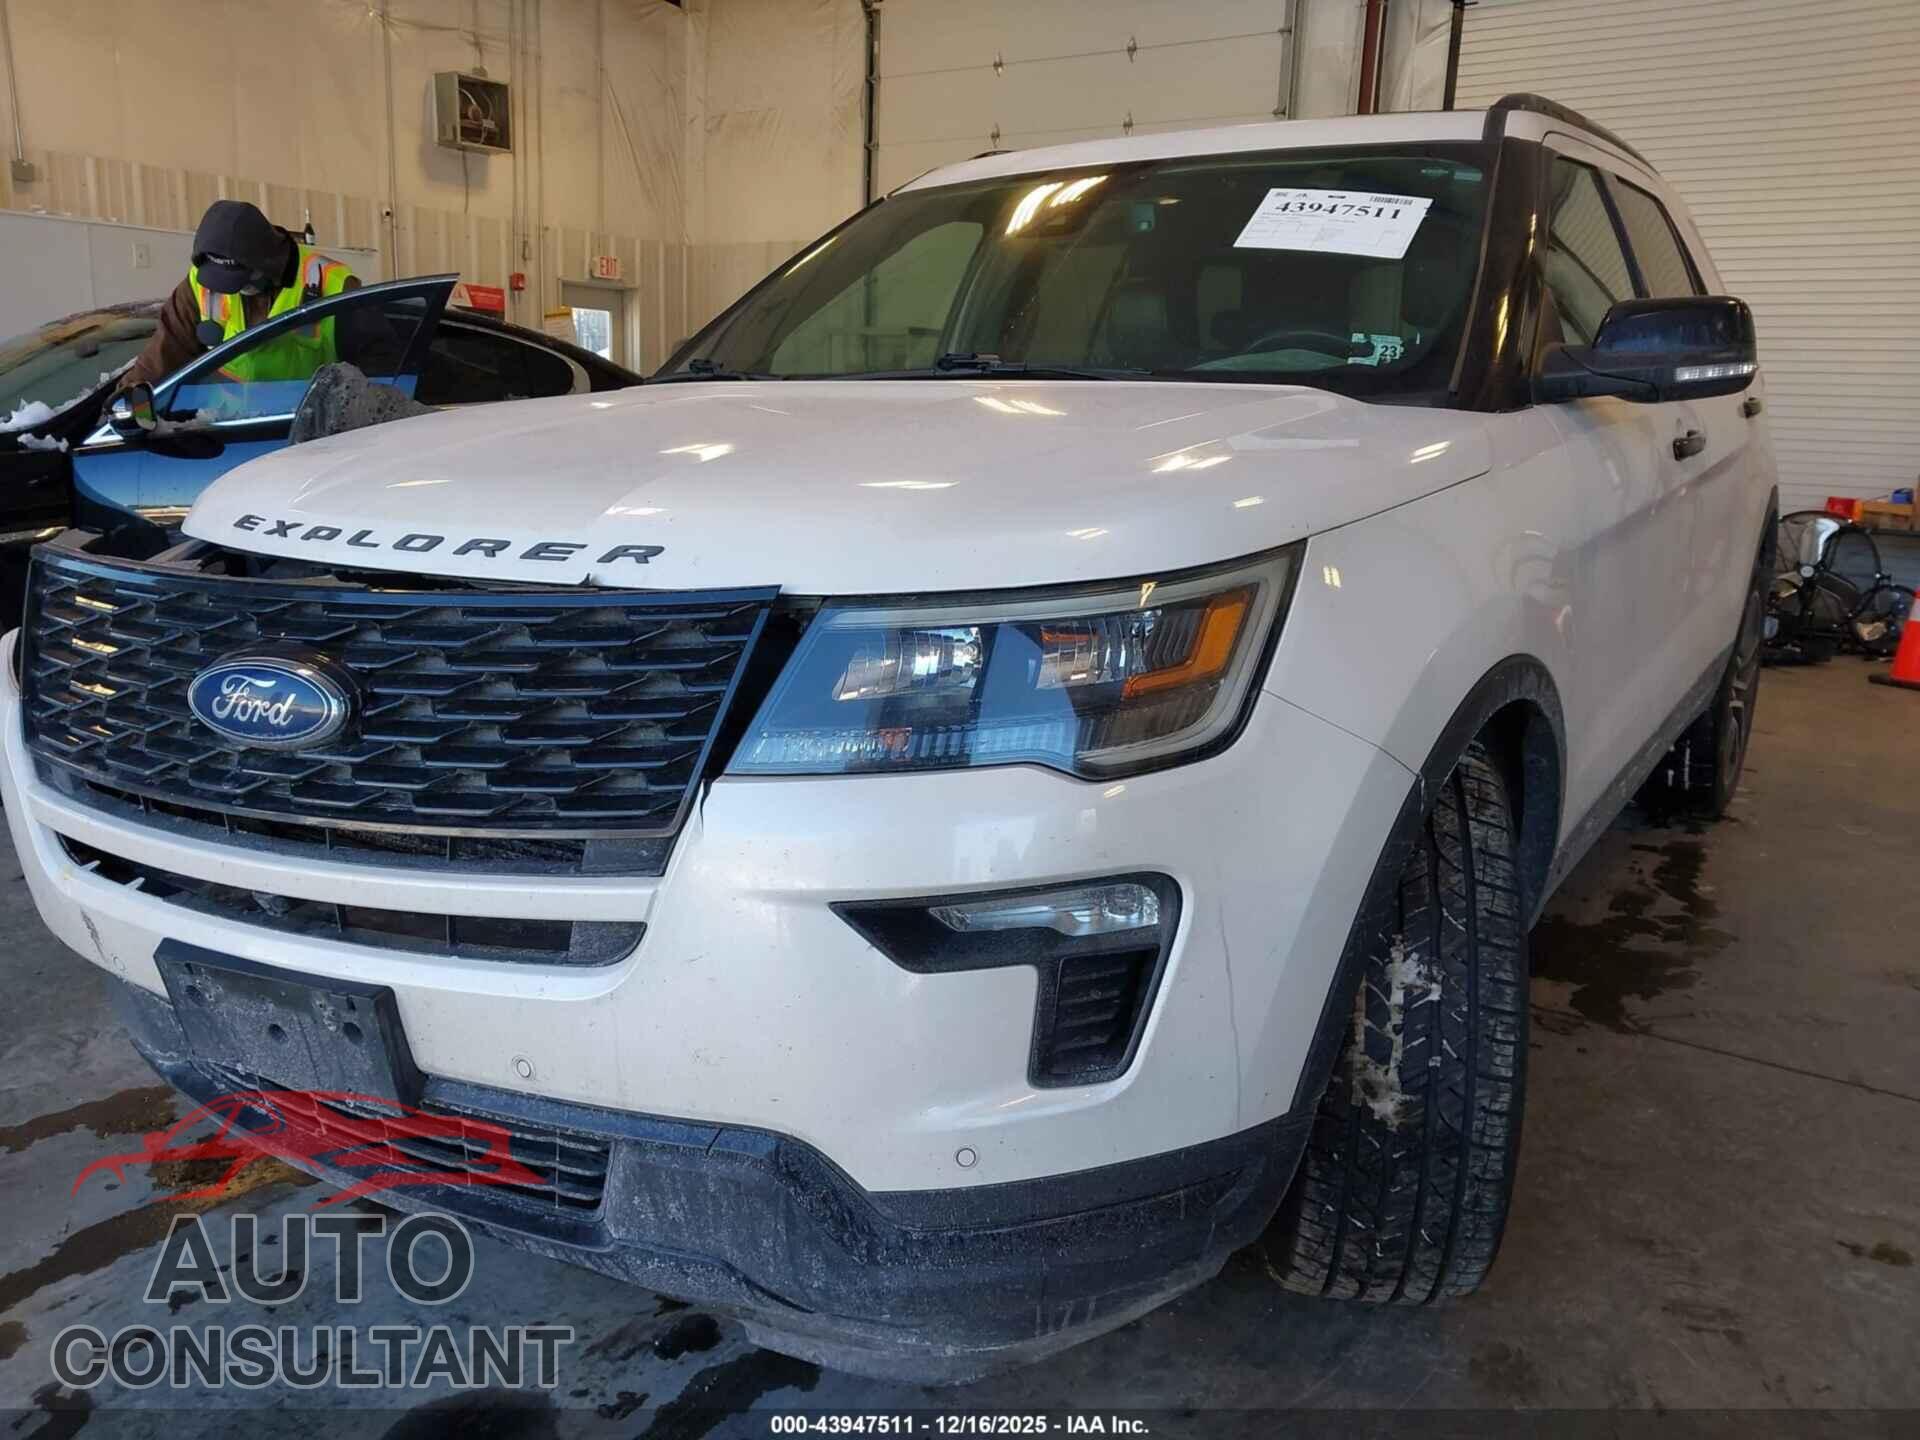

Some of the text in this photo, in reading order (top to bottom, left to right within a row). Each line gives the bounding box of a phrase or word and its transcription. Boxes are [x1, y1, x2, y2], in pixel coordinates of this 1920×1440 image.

[1275, 200, 1401, 220] 43947511
[599, 256, 618, 276] EXIT
[1380, 344, 1398, 358] 23
[232, 514, 665, 564] EXPLORER
[211, 674, 297, 726] Ford
